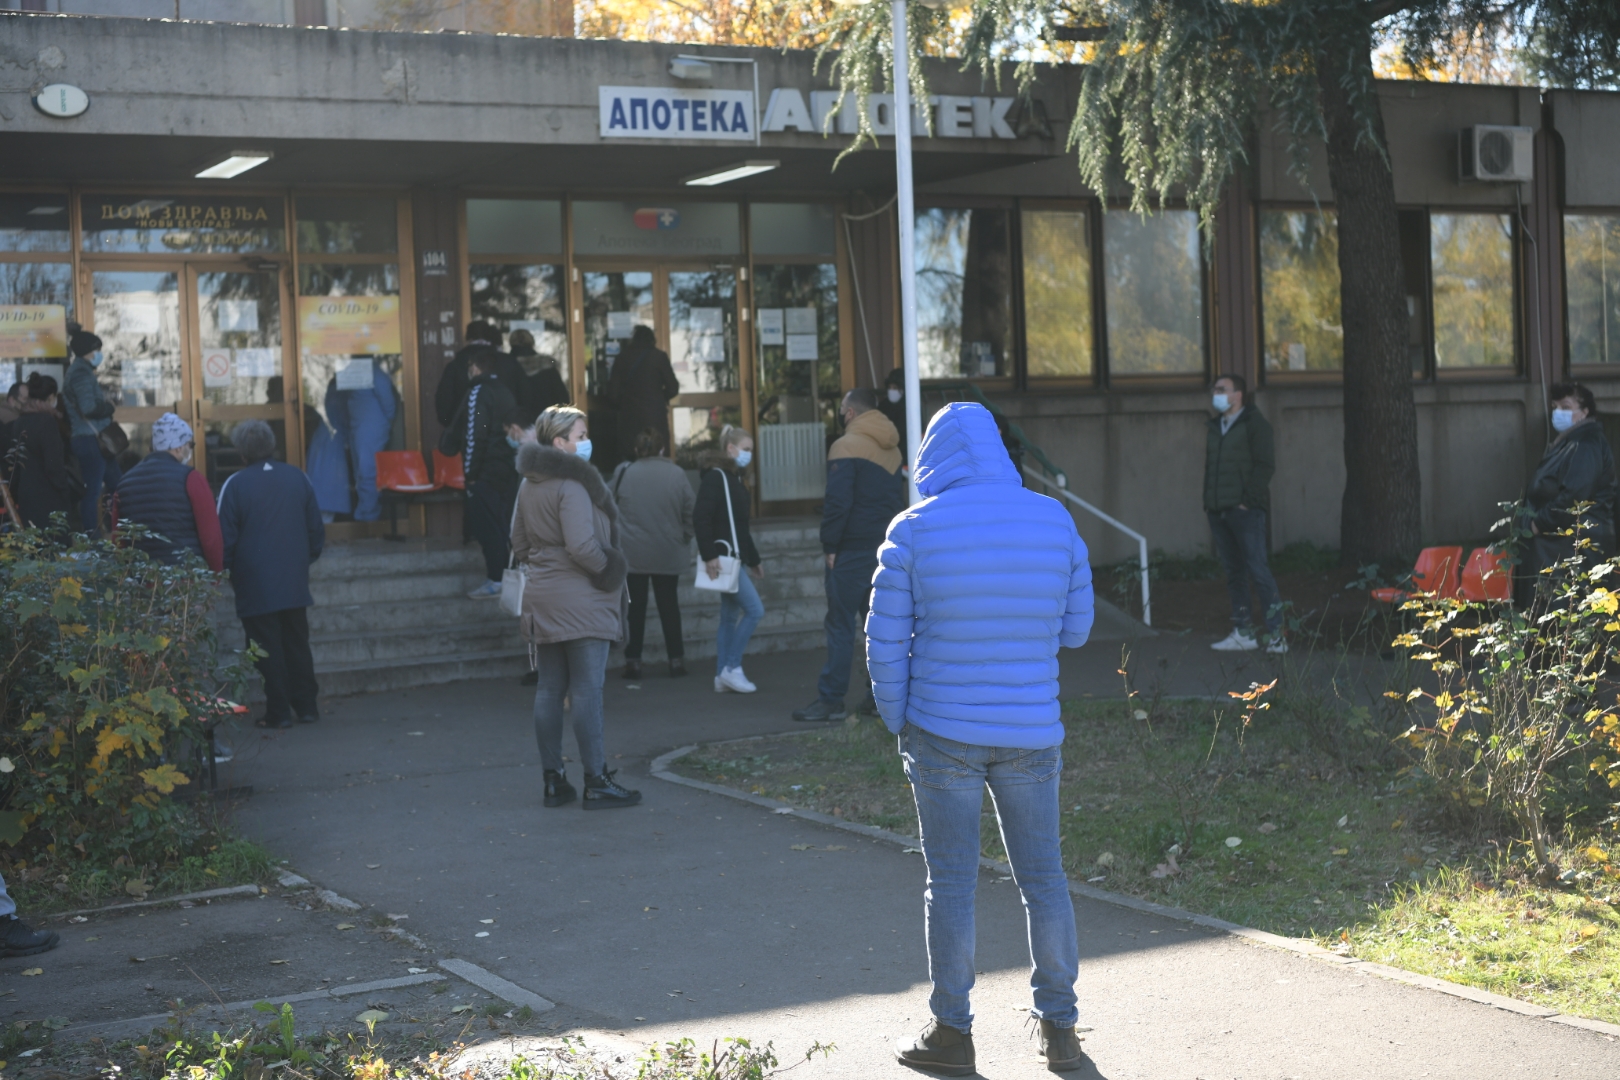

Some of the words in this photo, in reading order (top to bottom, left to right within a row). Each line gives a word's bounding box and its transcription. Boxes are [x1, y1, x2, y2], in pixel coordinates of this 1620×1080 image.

[609, 97, 748, 133] АПОТЕКА
[101, 204, 150, 220] ДОМ
[161, 205, 268, 221] ЗДРАВЉА
[318, 303, 379, 315] COVID-19
